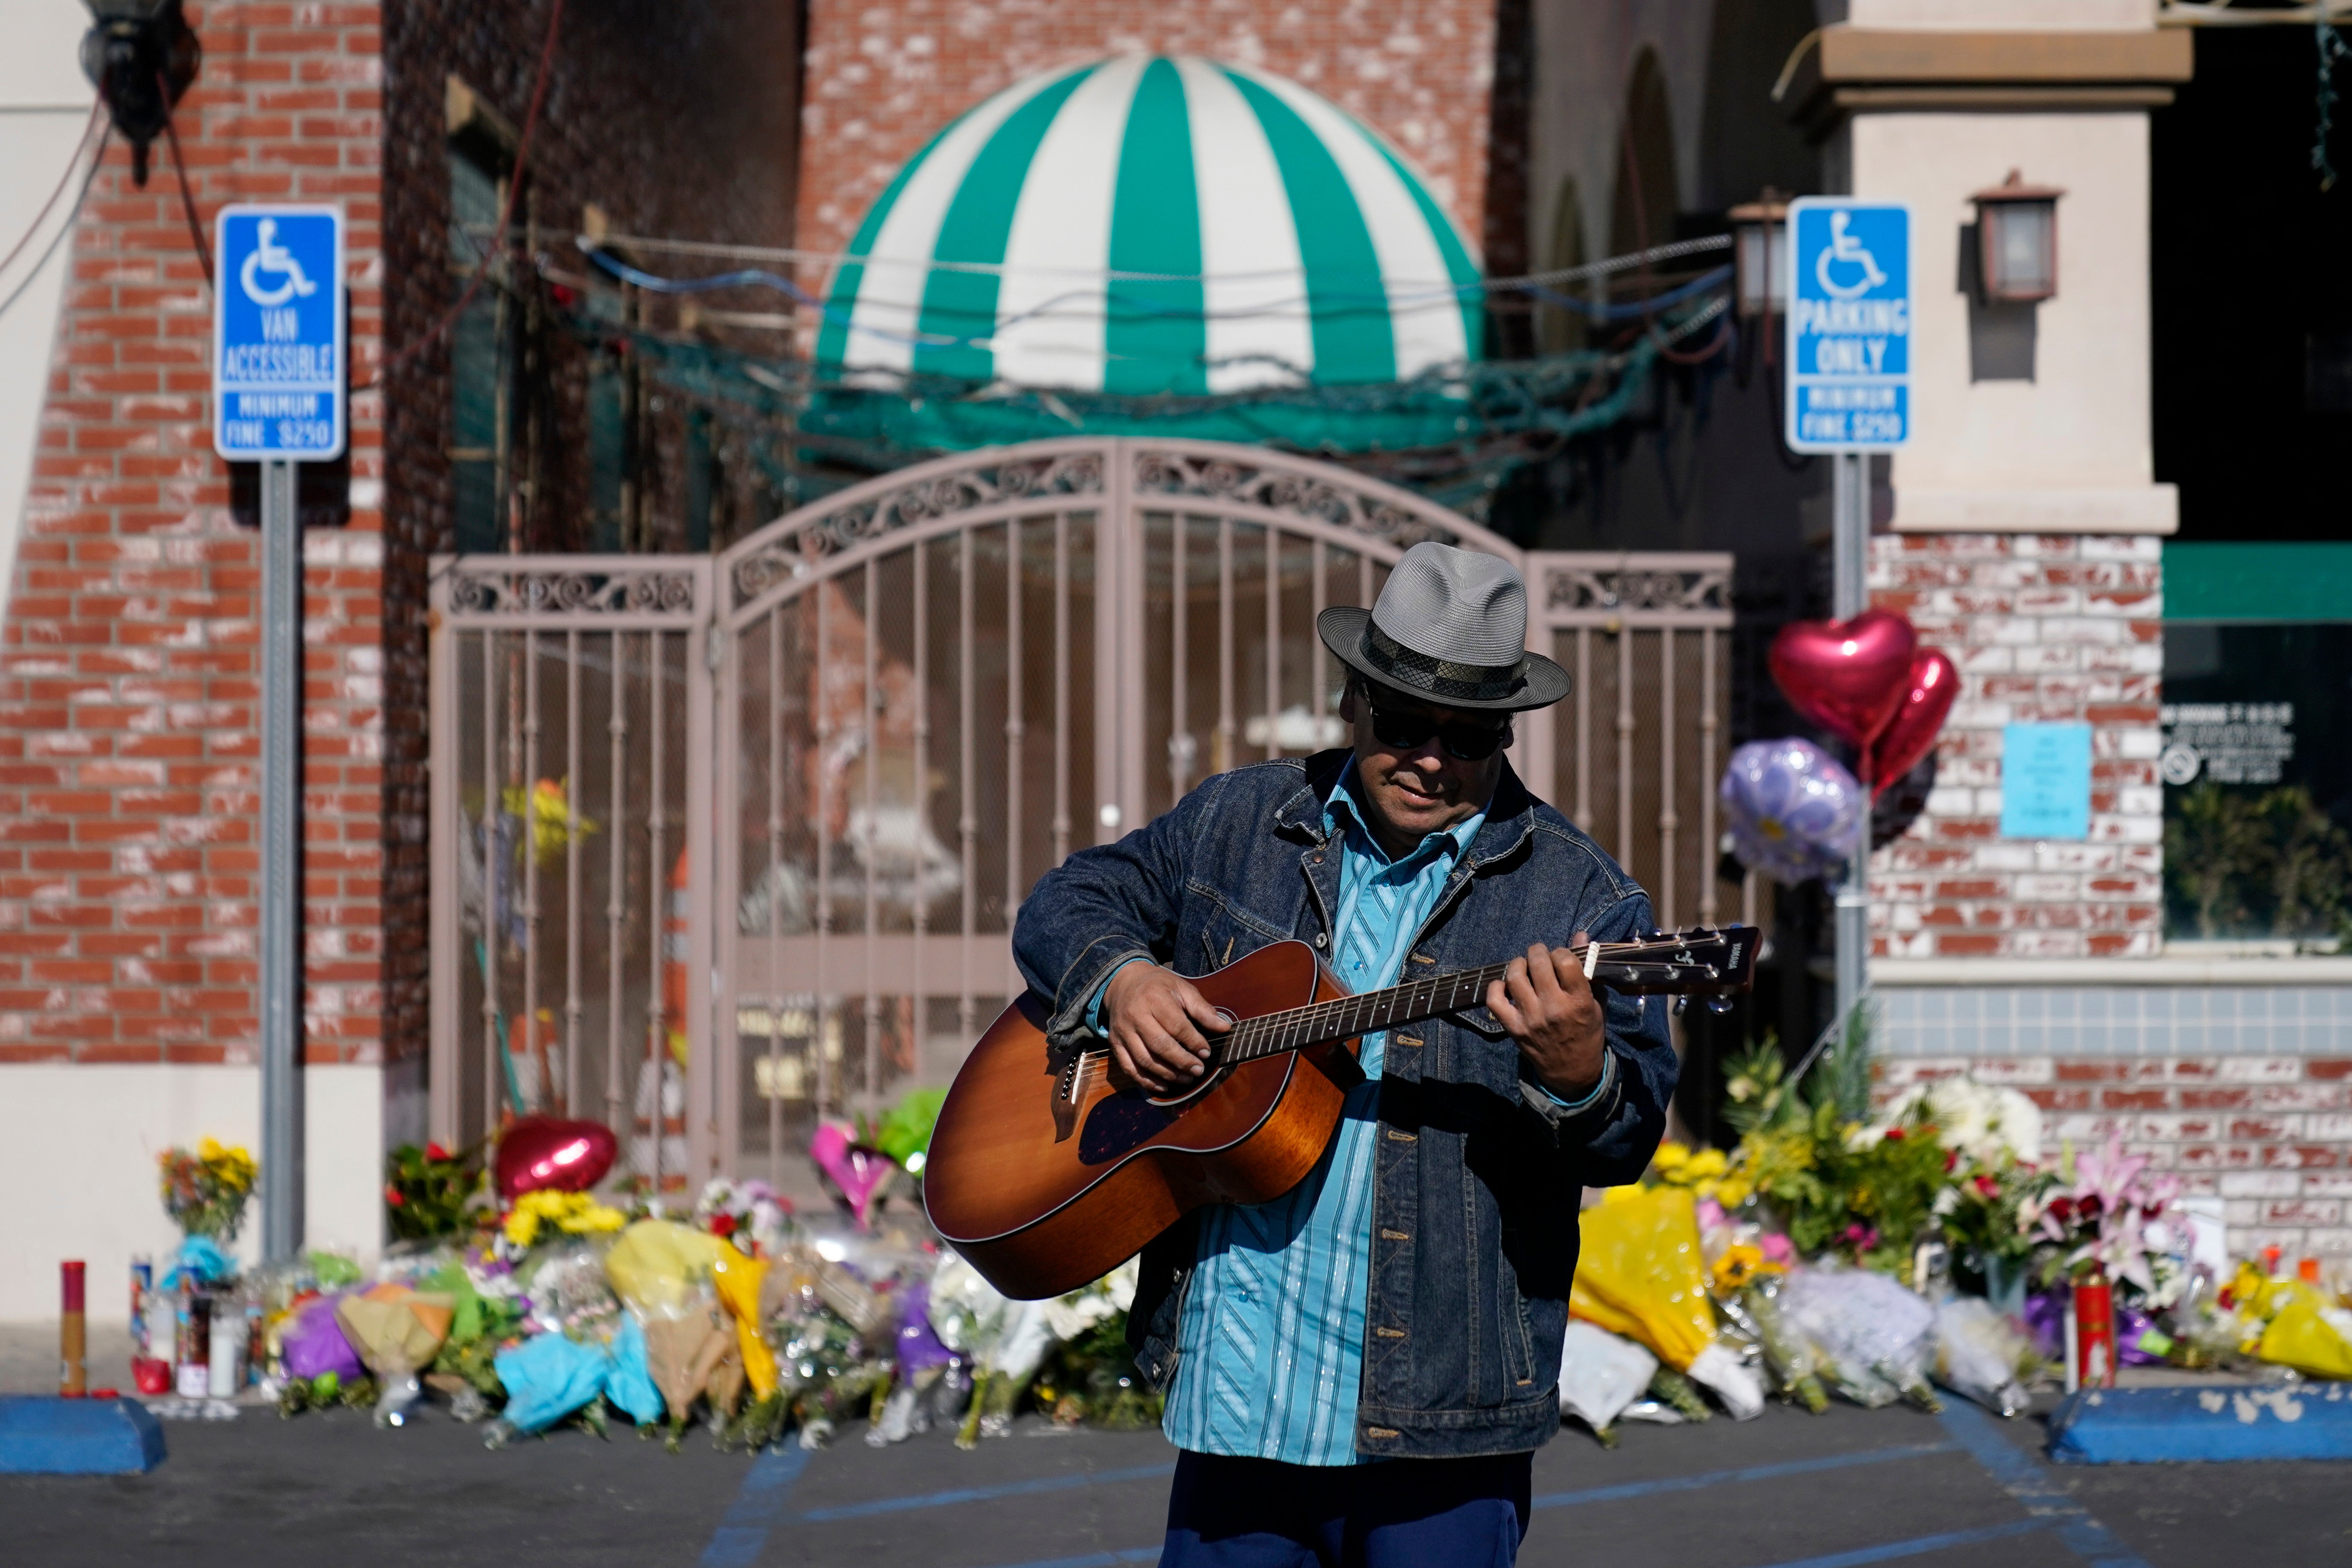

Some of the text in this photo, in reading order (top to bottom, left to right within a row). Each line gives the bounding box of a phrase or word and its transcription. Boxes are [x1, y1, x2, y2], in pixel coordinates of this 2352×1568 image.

[260, 308, 297, 342] VAN
[1798, 299, 1906, 335] PARKING
[226, 344, 331, 382] ACCESSIBLE
[1816, 338, 1887, 373] ONLY
[239, 393, 318, 418] MINIMUM
[226, 420, 329, 447] FINE $250
[1727, 942, 1743, 970] YAMAHA
